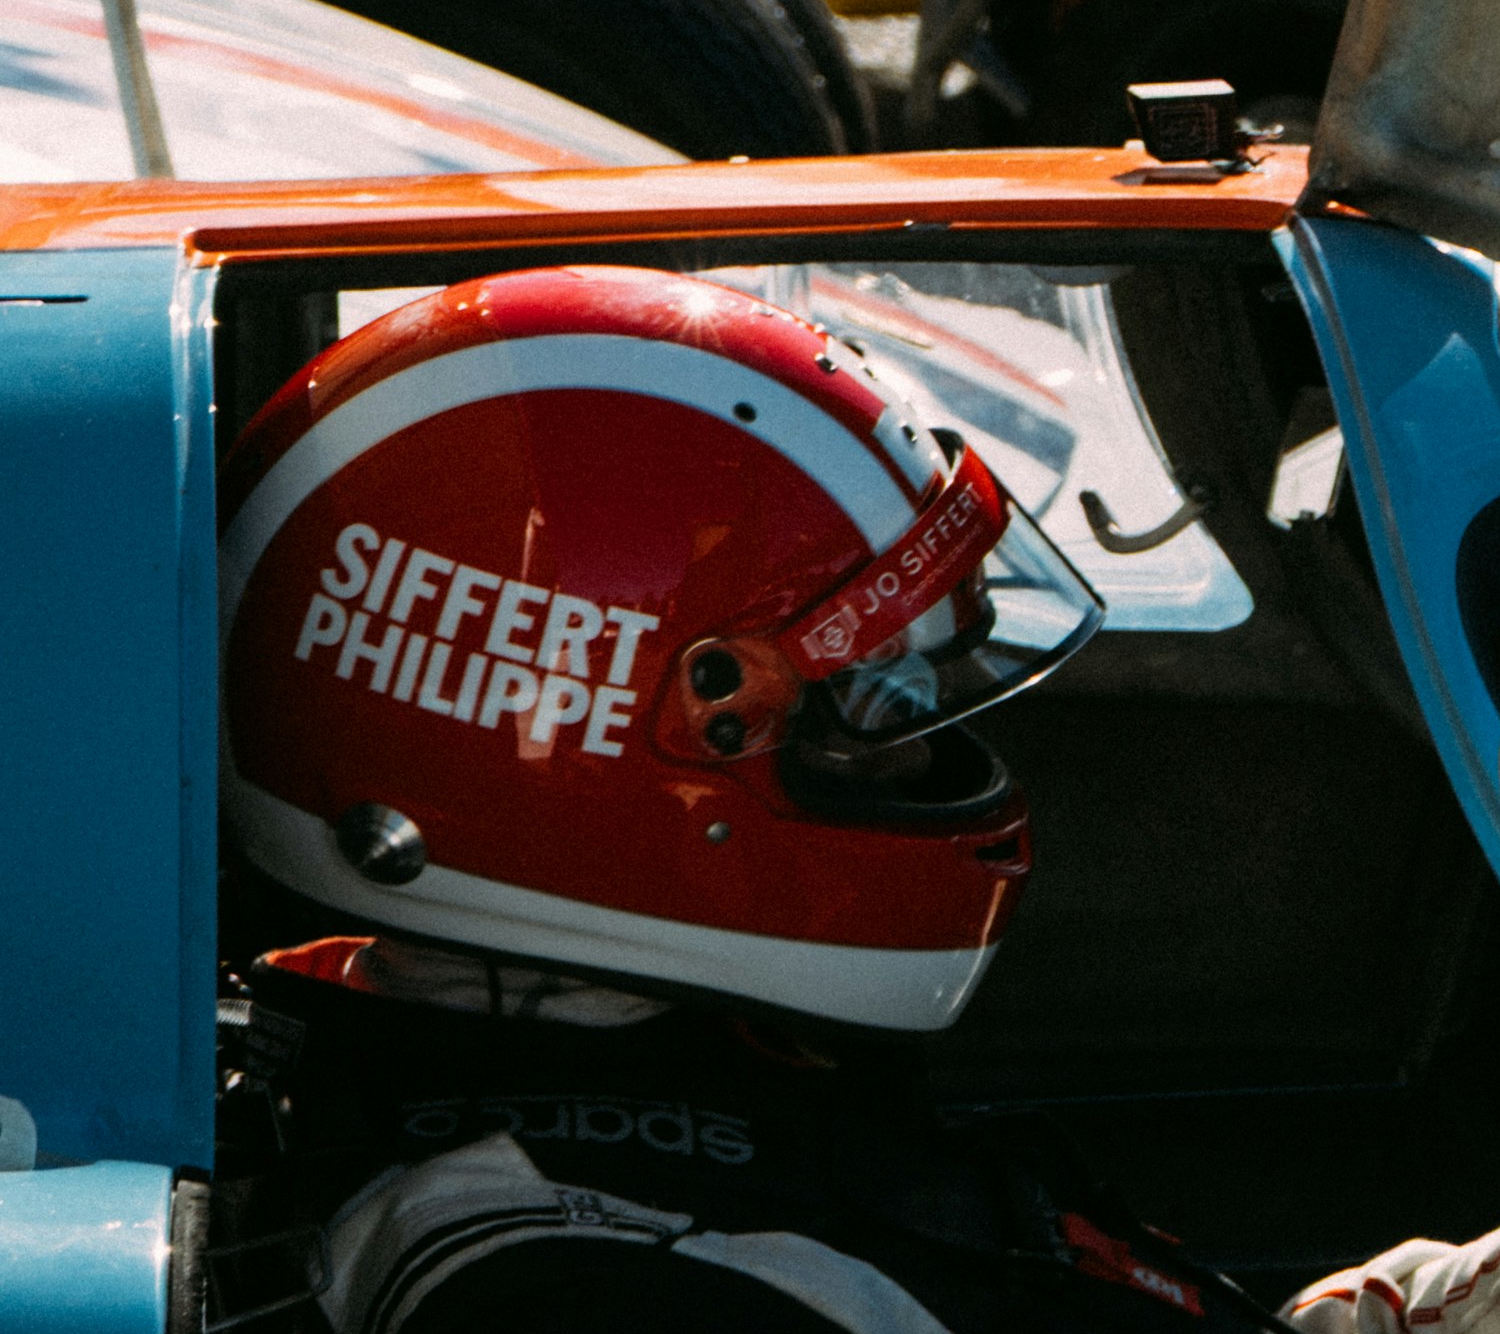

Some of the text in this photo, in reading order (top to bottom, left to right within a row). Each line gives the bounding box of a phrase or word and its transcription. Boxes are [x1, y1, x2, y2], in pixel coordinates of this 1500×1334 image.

[320, 523, 660, 686] SIFFERT
[862, 481, 984, 616] JO SIFFERT
[295, 592, 637, 758] PHILIPPE
[403, 1102, 755, 1165] sparco
